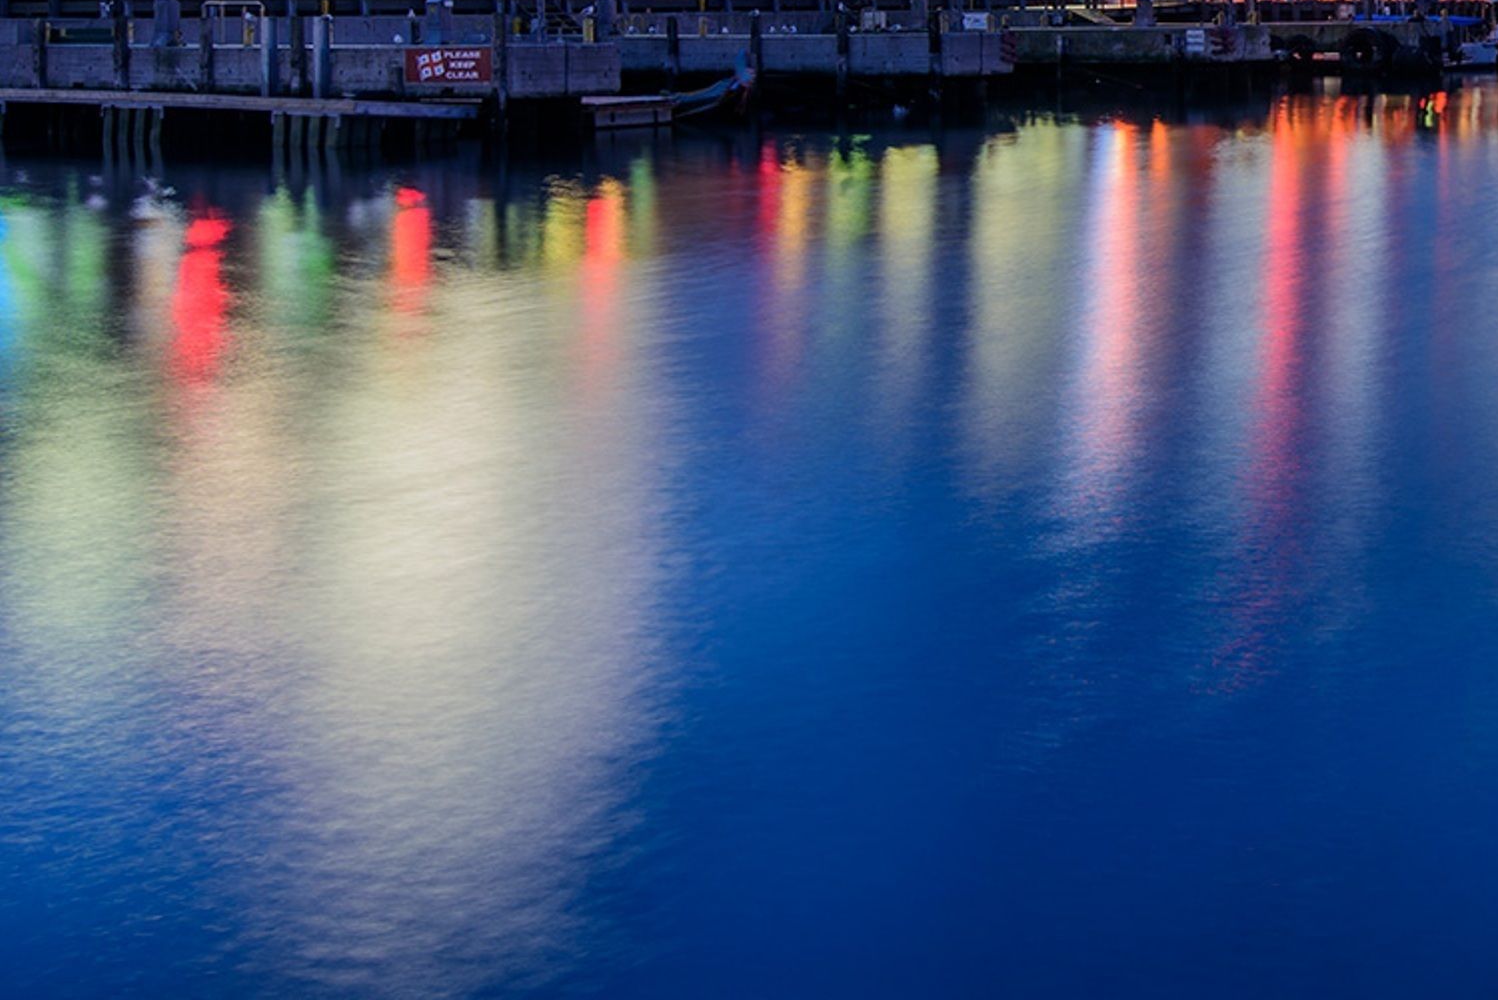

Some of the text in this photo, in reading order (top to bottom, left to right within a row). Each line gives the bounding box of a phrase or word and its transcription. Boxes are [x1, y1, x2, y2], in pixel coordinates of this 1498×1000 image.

[443, 50, 481, 59] PLEASE
[449, 61, 476, 69] KEEP
[445, 71, 479, 79] CLEAR
